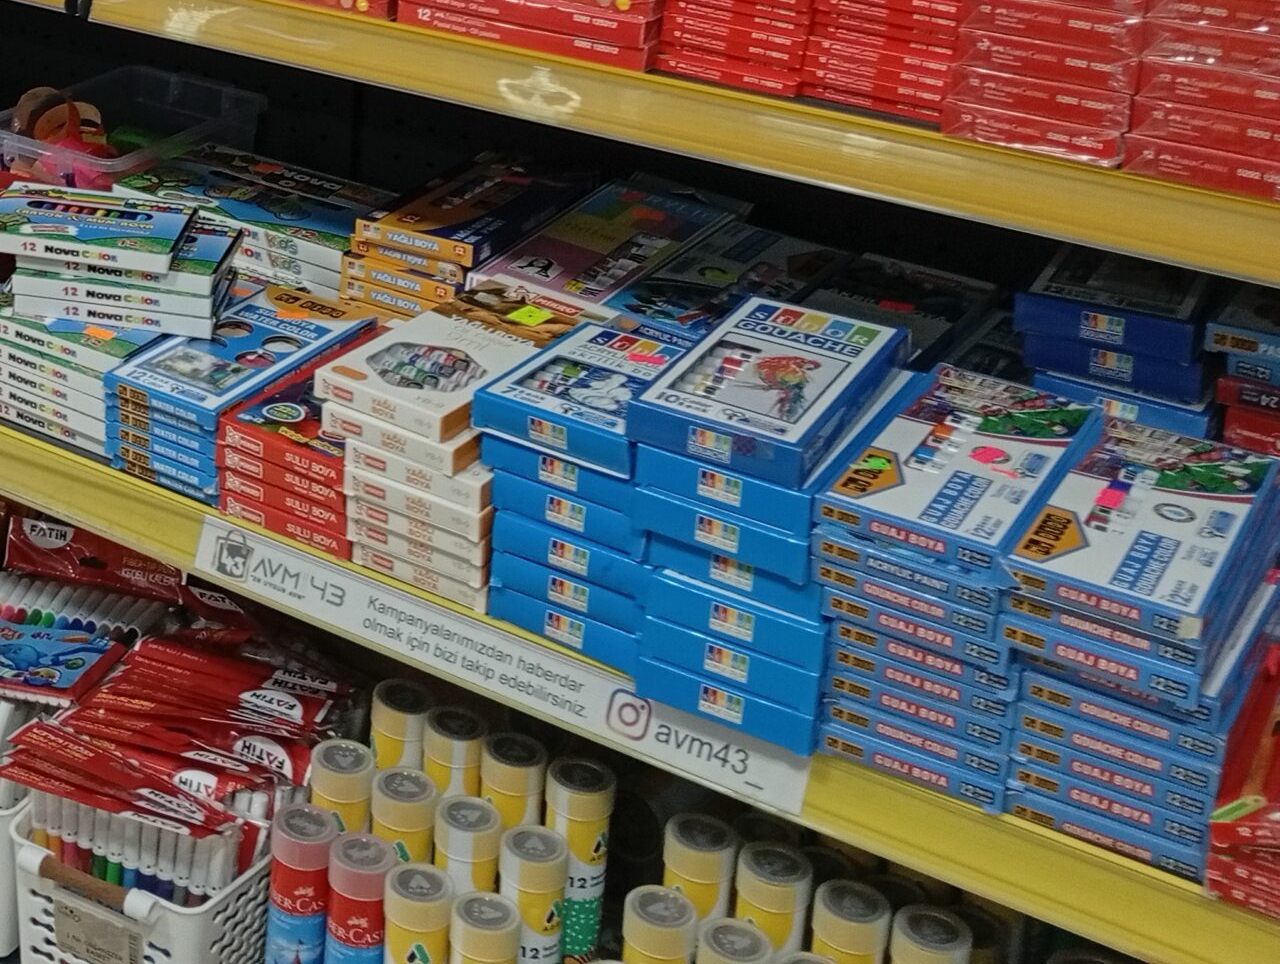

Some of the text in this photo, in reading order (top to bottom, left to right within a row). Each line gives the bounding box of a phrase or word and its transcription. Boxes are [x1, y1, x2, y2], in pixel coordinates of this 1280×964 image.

[19, 241, 80, 259] 12 Nova
[63, 261, 123, 278] 12 Nova
[61, 286, 123, 303] 12 Nova
[63, 305, 124, 323] 12 Nova
[14, 328, 46, 348] Nova
[277, 321, 318, 339] COLOR
[737, 319, 862, 357] GOUACHE
[8, 352, 38, 372] Nova
[15, 410, 46, 431] Nova
[284, 451, 337, 481] SULU BOYA
[284, 473, 337, 501] SULU BOYA
[285, 496, 338, 524] SULU BOYA
[285, 522, 339, 551] SULU BOYA
[252, 557, 347, 608] AVM 43
[362, 616, 402, 643] olmak
[404, 630, 430, 655] için
[432, 639, 458, 662] bizi
[459, 649, 495, 683] takip
[366, 593, 585, 695] Kampanyalarımızdan haberdar
[654, 722, 764, 791] avm43_
[568, 875, 588, 889] 12
[521, 945, 540, 959] 12
